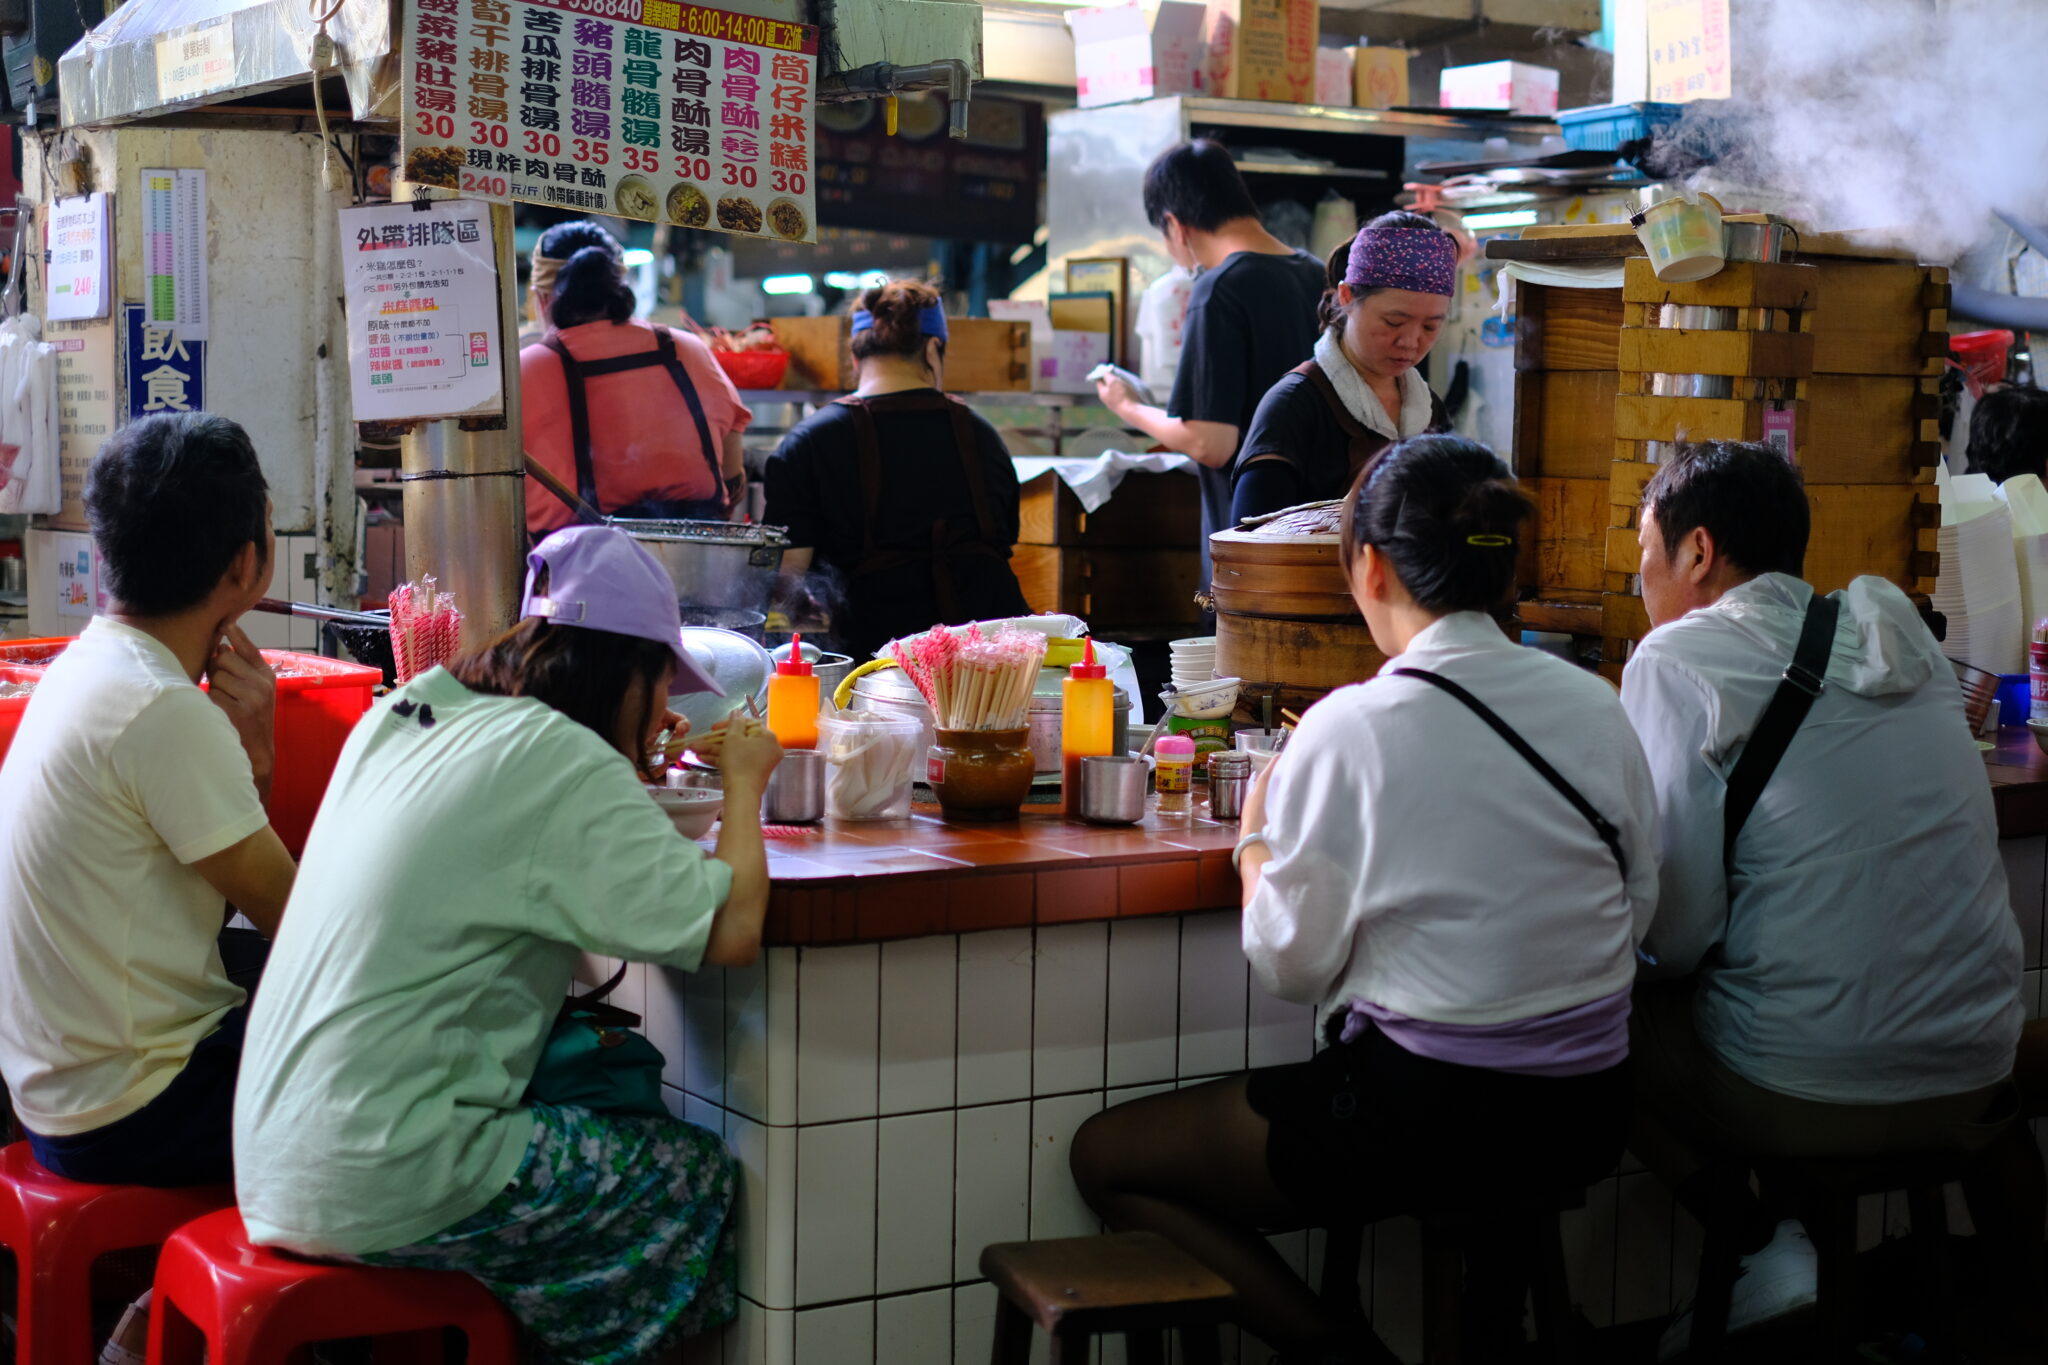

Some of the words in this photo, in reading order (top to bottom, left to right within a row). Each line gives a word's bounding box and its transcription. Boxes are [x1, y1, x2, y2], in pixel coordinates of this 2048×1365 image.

[519, 7, 564, 131] 苦瓜排骨湯
[415, 111, 455, 139] 30
[770, 53, 809, 172] 筒仔米糕
[470, 121, 508, 148] 30
[523, 130, 561, 157] 30
[572, 138, 610, 165] 35
[622, 146, 660, 173] 35
[466, 149, 607, 189] 現炸肉骨酥
[674, 155, 711, 181] 30
[721, 162, 758, 188] 30
[462, 172, 507, 197] 240
[771, 170, 806, 195] 30
[356, 218, 481, 251] 外帶排隊區
